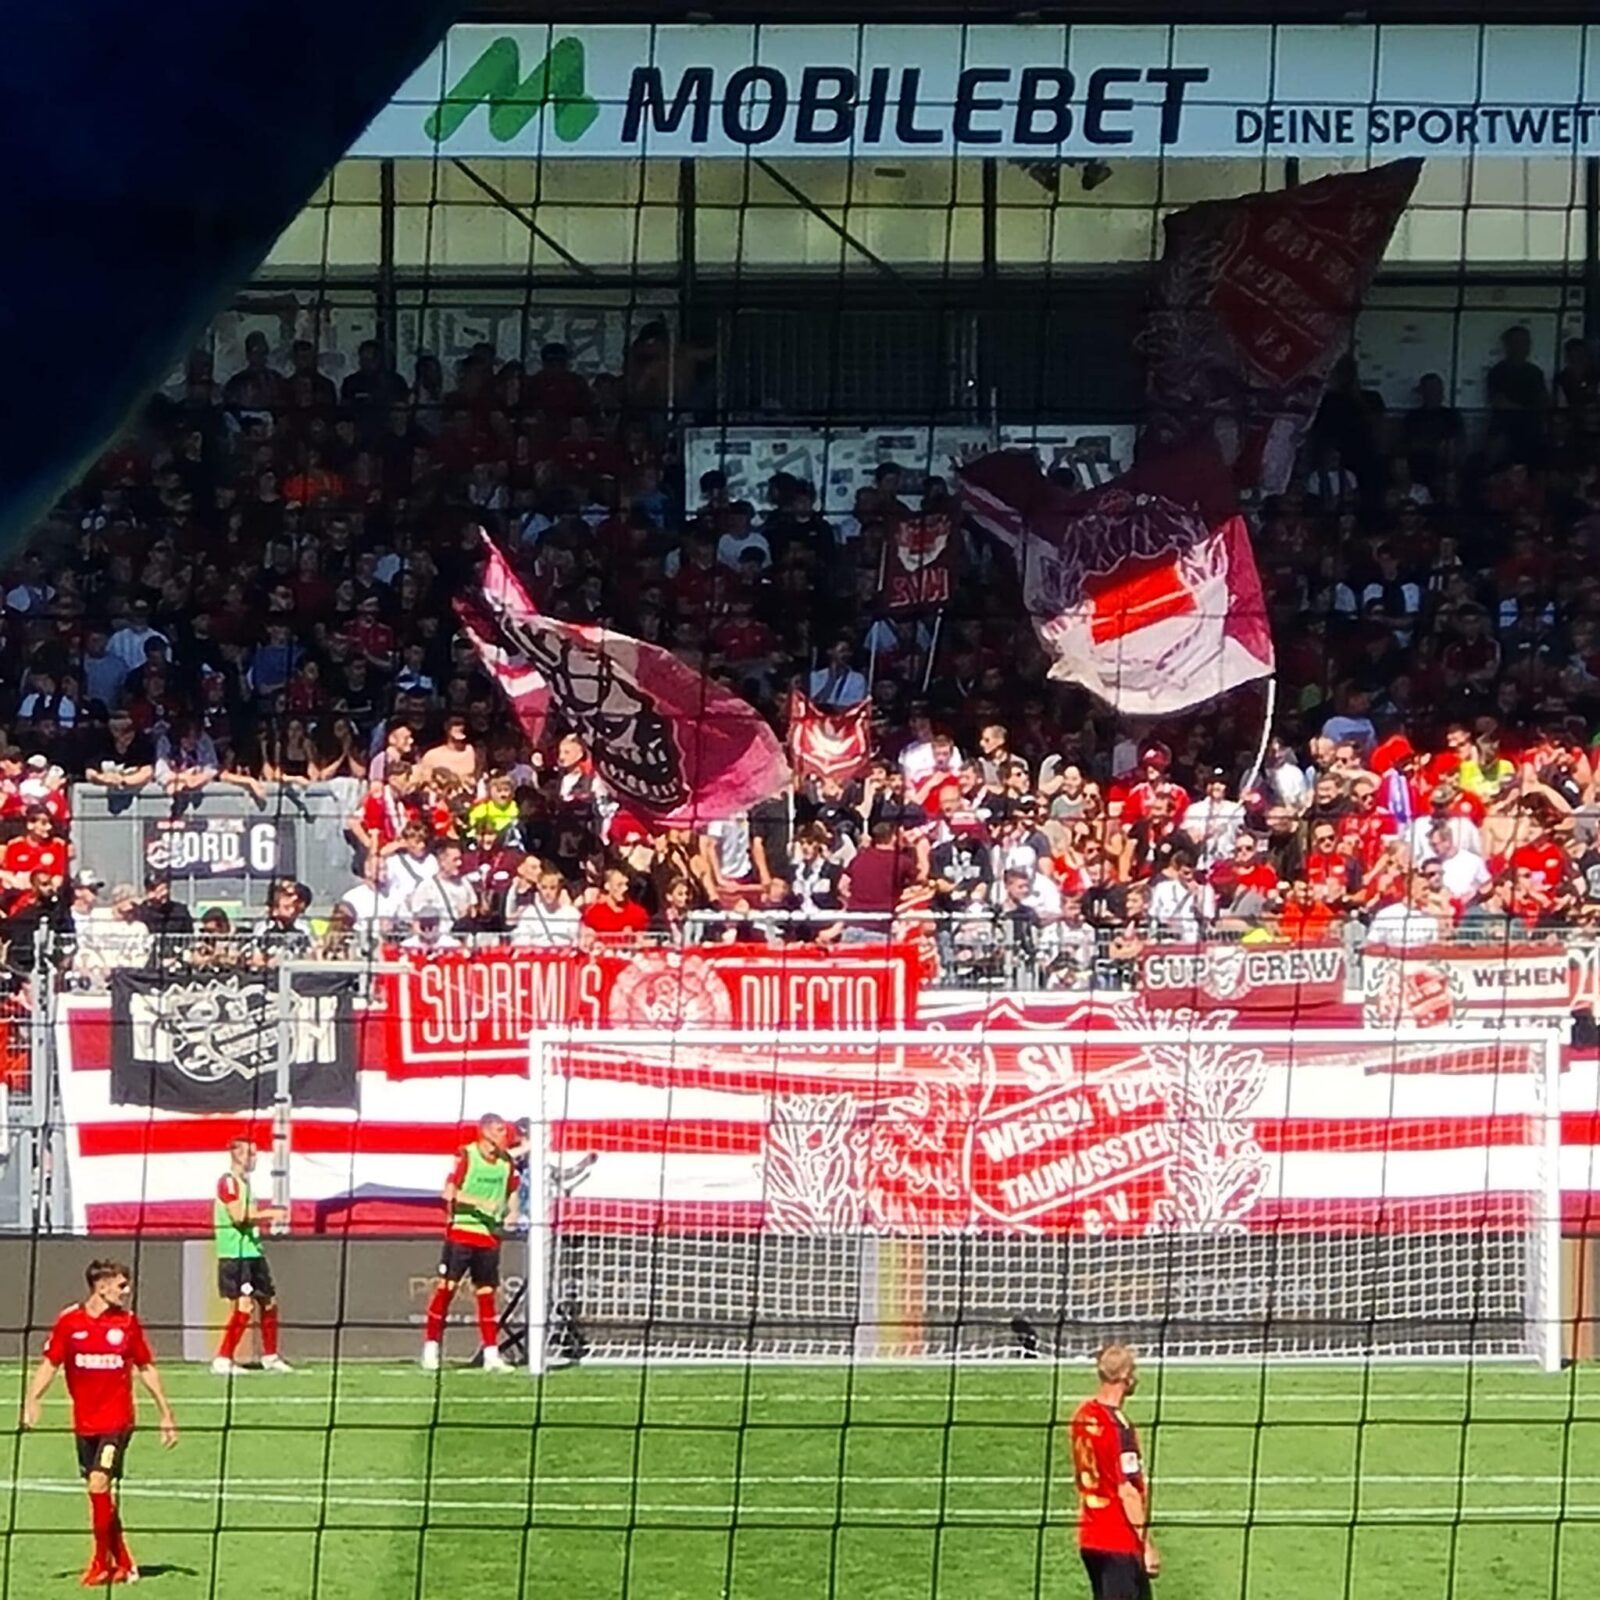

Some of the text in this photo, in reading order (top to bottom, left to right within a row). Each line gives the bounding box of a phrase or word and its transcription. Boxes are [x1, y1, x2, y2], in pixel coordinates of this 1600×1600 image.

[620, 66, 1210, 144] MOBILEBET
[1236, 108, 1600, 145] DEINE SPORTWET
[250, 823, 277, 871] 6
[1146, 949, 1340, 988] SUP CREW
[1473, 967, 1567, 987] WEHEN
[1017, 1046, 1074, 1092] SV
[979, 1095, 1093, 1162] WEHEN
